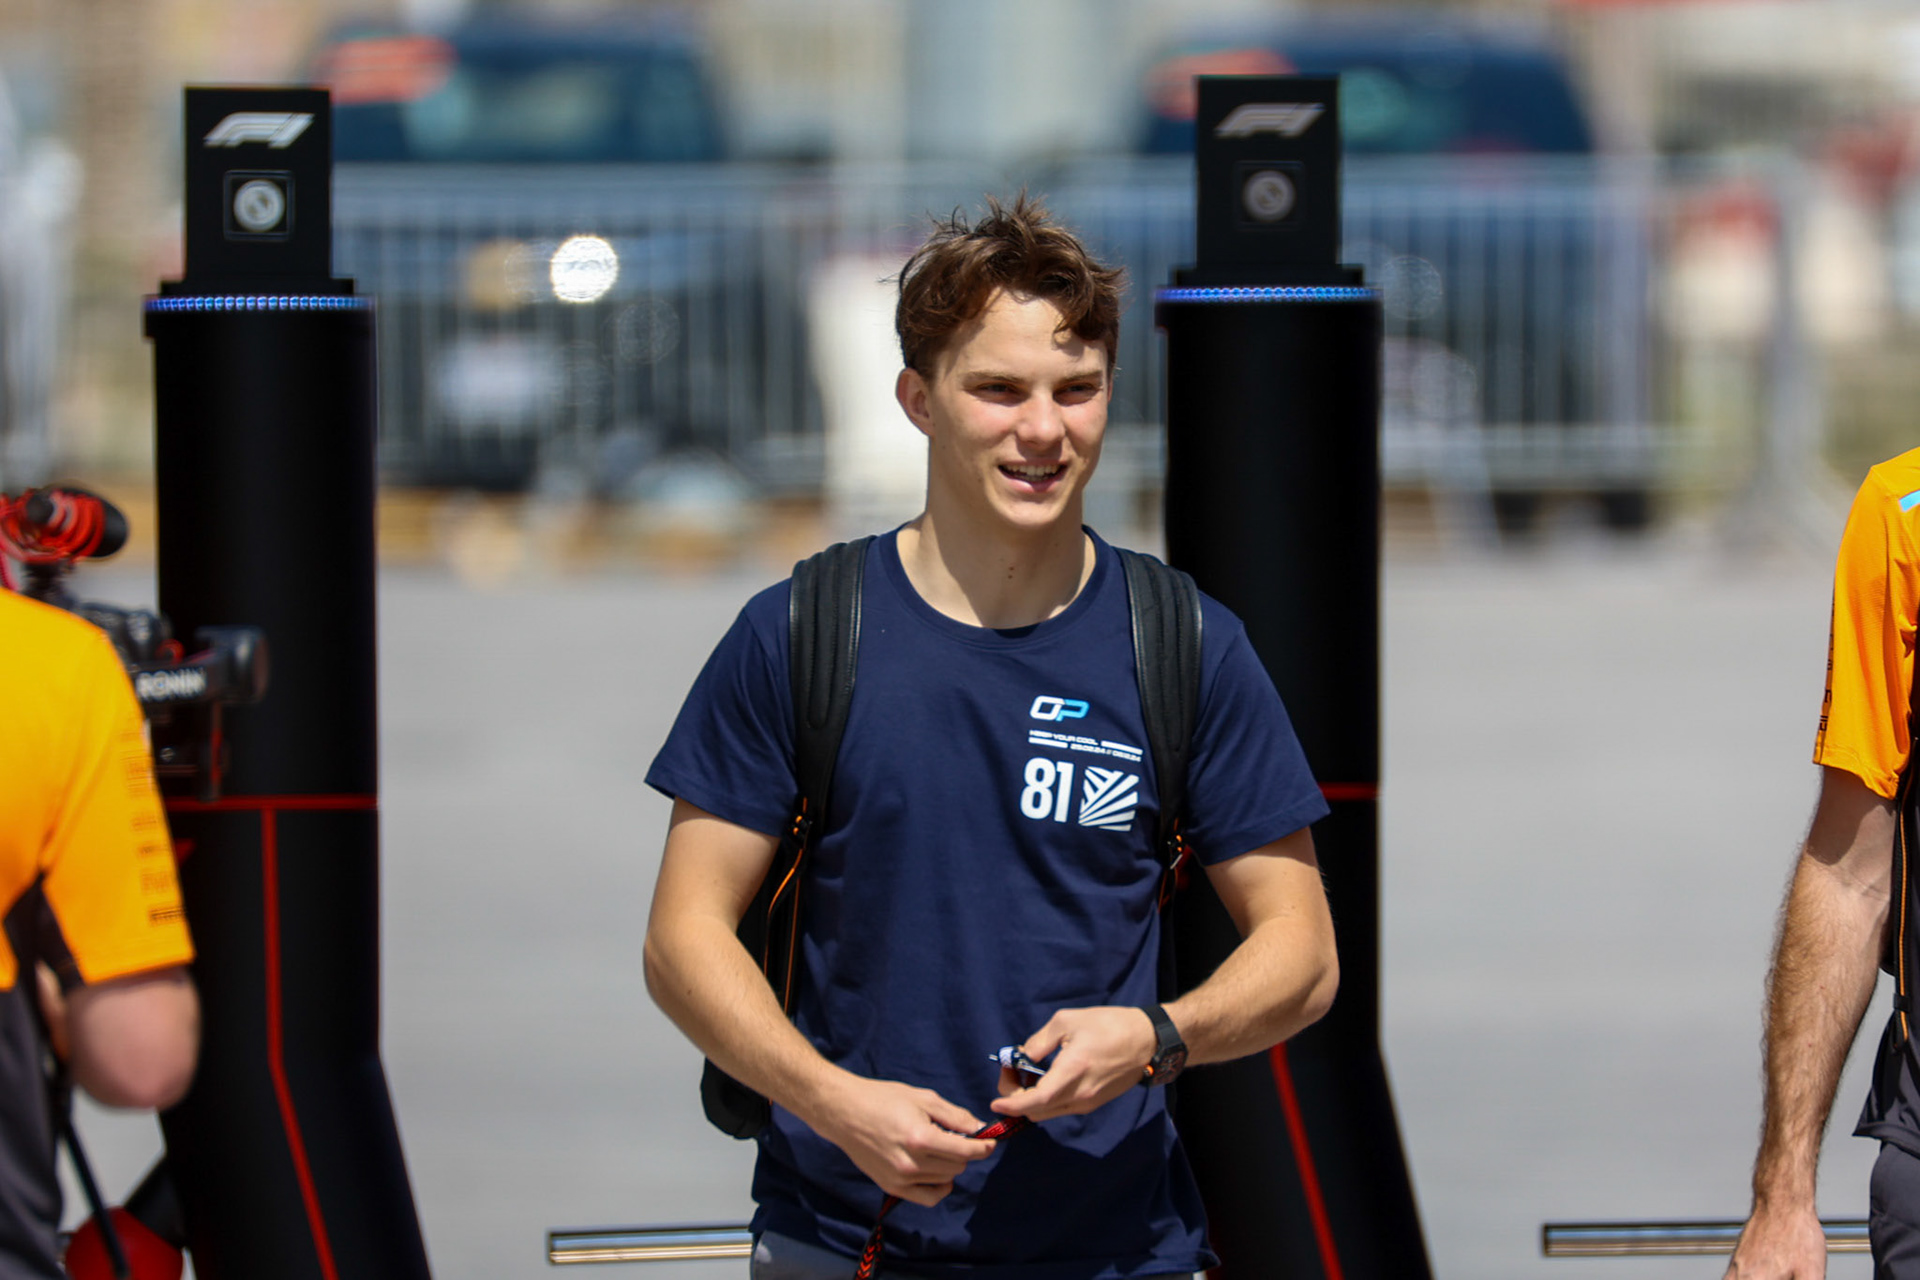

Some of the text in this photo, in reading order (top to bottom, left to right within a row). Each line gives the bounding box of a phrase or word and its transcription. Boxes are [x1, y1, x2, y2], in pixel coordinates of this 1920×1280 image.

[203, 112, 315, 148] F1
[136, 668, 206, 700] RONIN
[1030, 695, 1090, 722] OP
[1053, 733, 1076, 743] YOUR
[1020, 757, 1075, 823] 81
